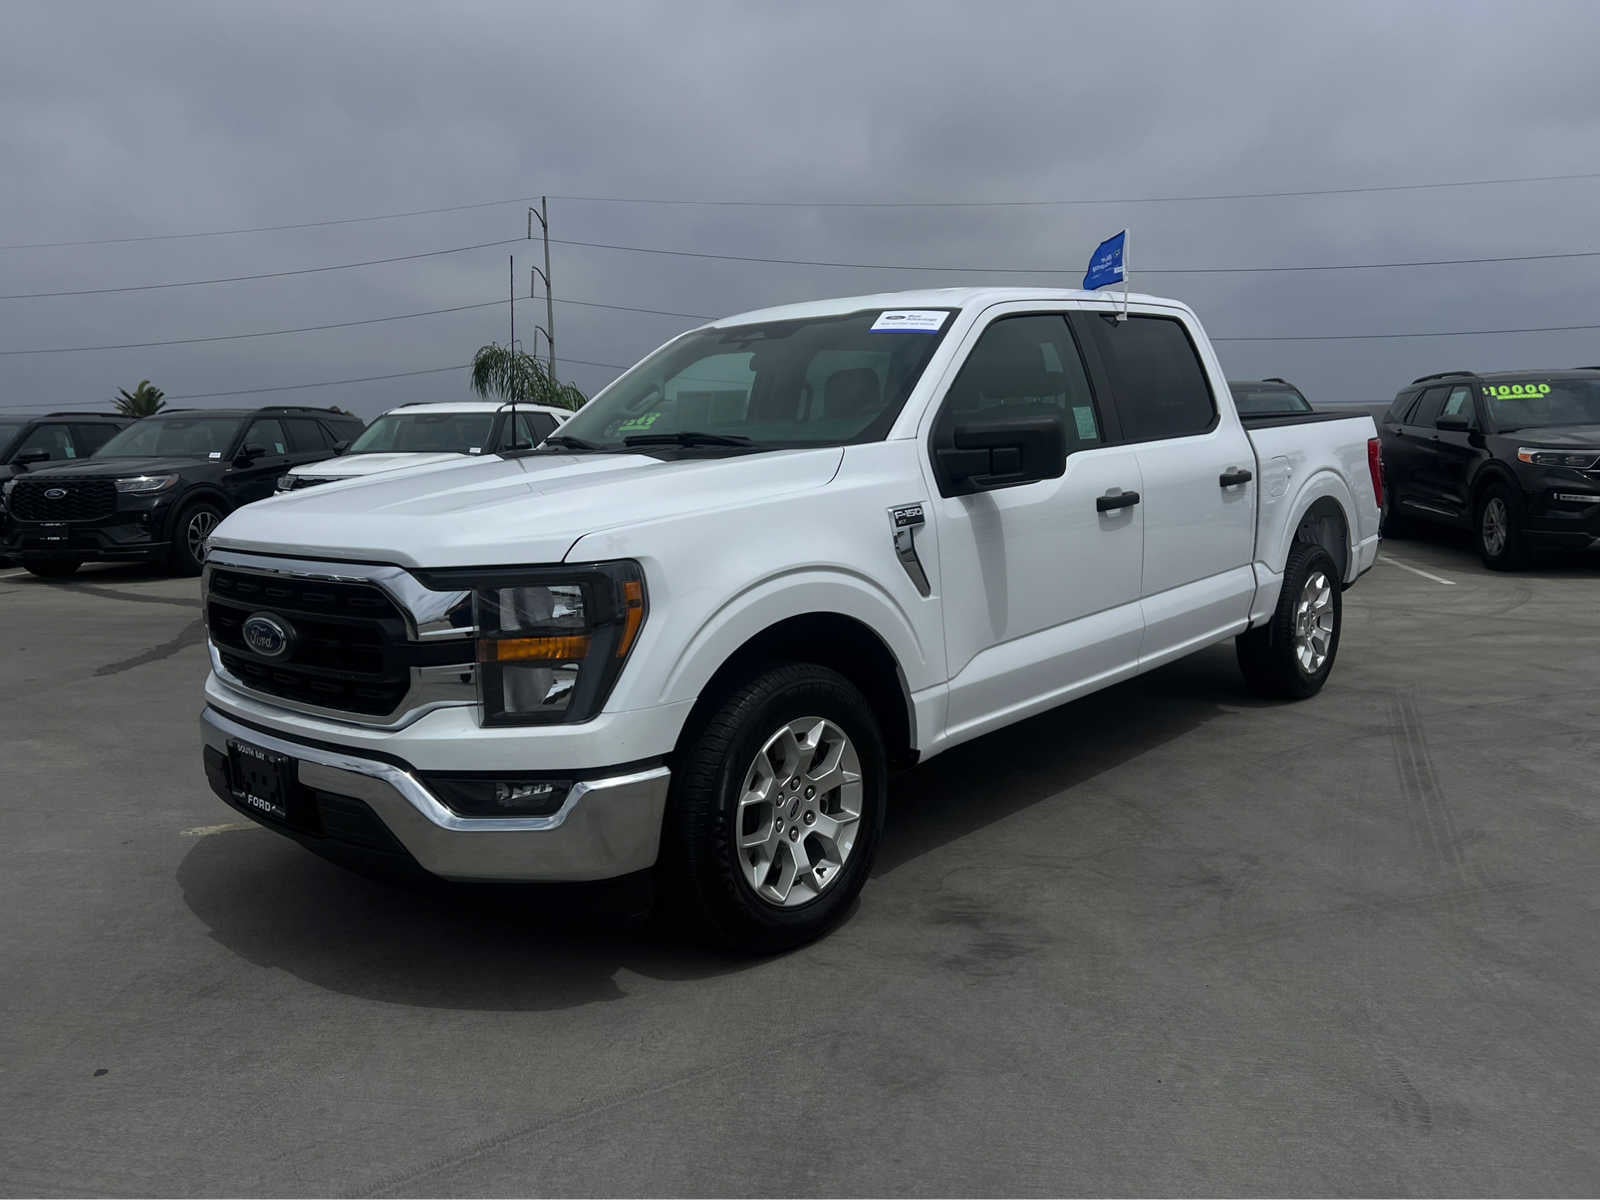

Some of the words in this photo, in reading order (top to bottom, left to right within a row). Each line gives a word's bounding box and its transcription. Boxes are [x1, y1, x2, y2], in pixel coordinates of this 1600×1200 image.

[895, 508, 922, 519] F-150
[249, 625, 272, 649] Ford
[247, 794, 271, 812] FORD
